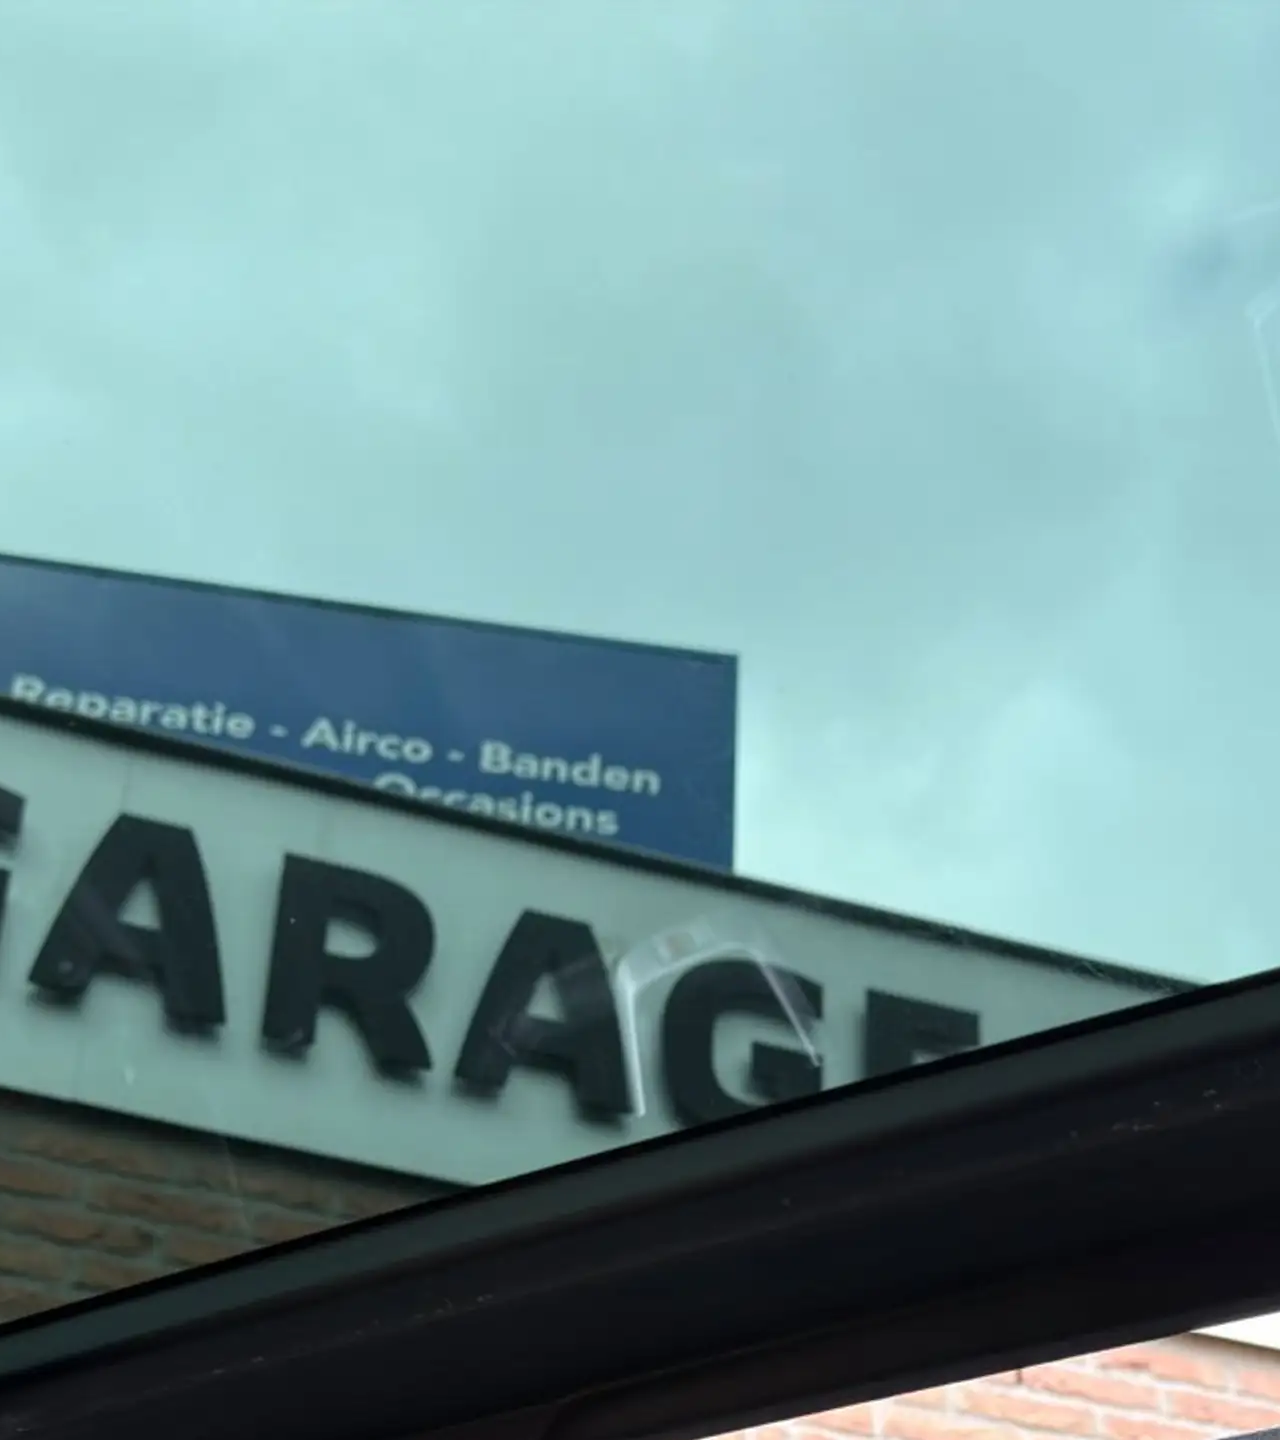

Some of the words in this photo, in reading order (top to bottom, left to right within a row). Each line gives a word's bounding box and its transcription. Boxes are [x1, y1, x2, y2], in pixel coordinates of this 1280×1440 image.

[9, 670, 257, 738] Reparatie
[300, 716, 434, 764] Airco
[478, 738, 661, 797] Banden
